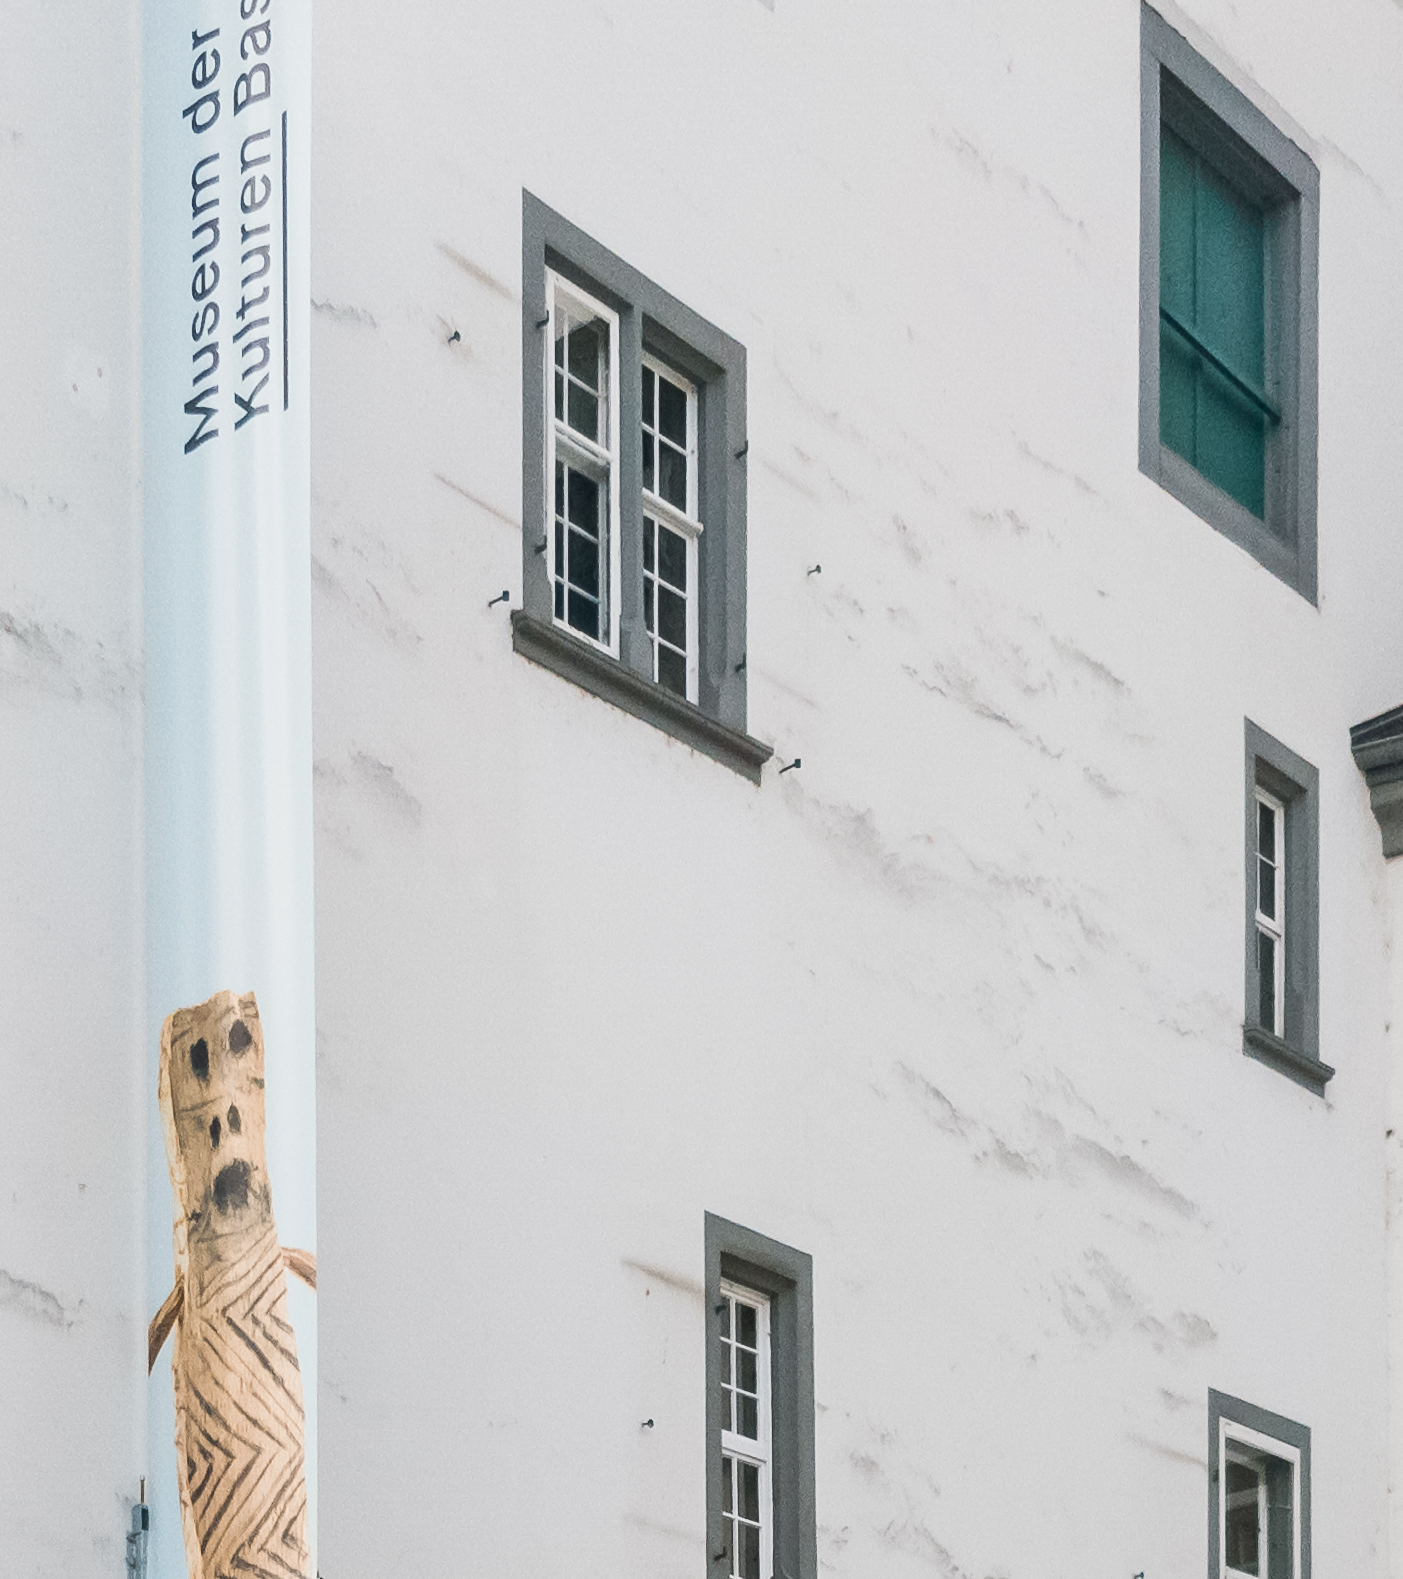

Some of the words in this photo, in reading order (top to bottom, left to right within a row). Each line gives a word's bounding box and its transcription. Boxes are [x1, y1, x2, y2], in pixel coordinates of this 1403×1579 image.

[182, 27, 221, 134] der
[183, 151, 221, 455] Museum
[232, 128, 271, 431] Kulturen
